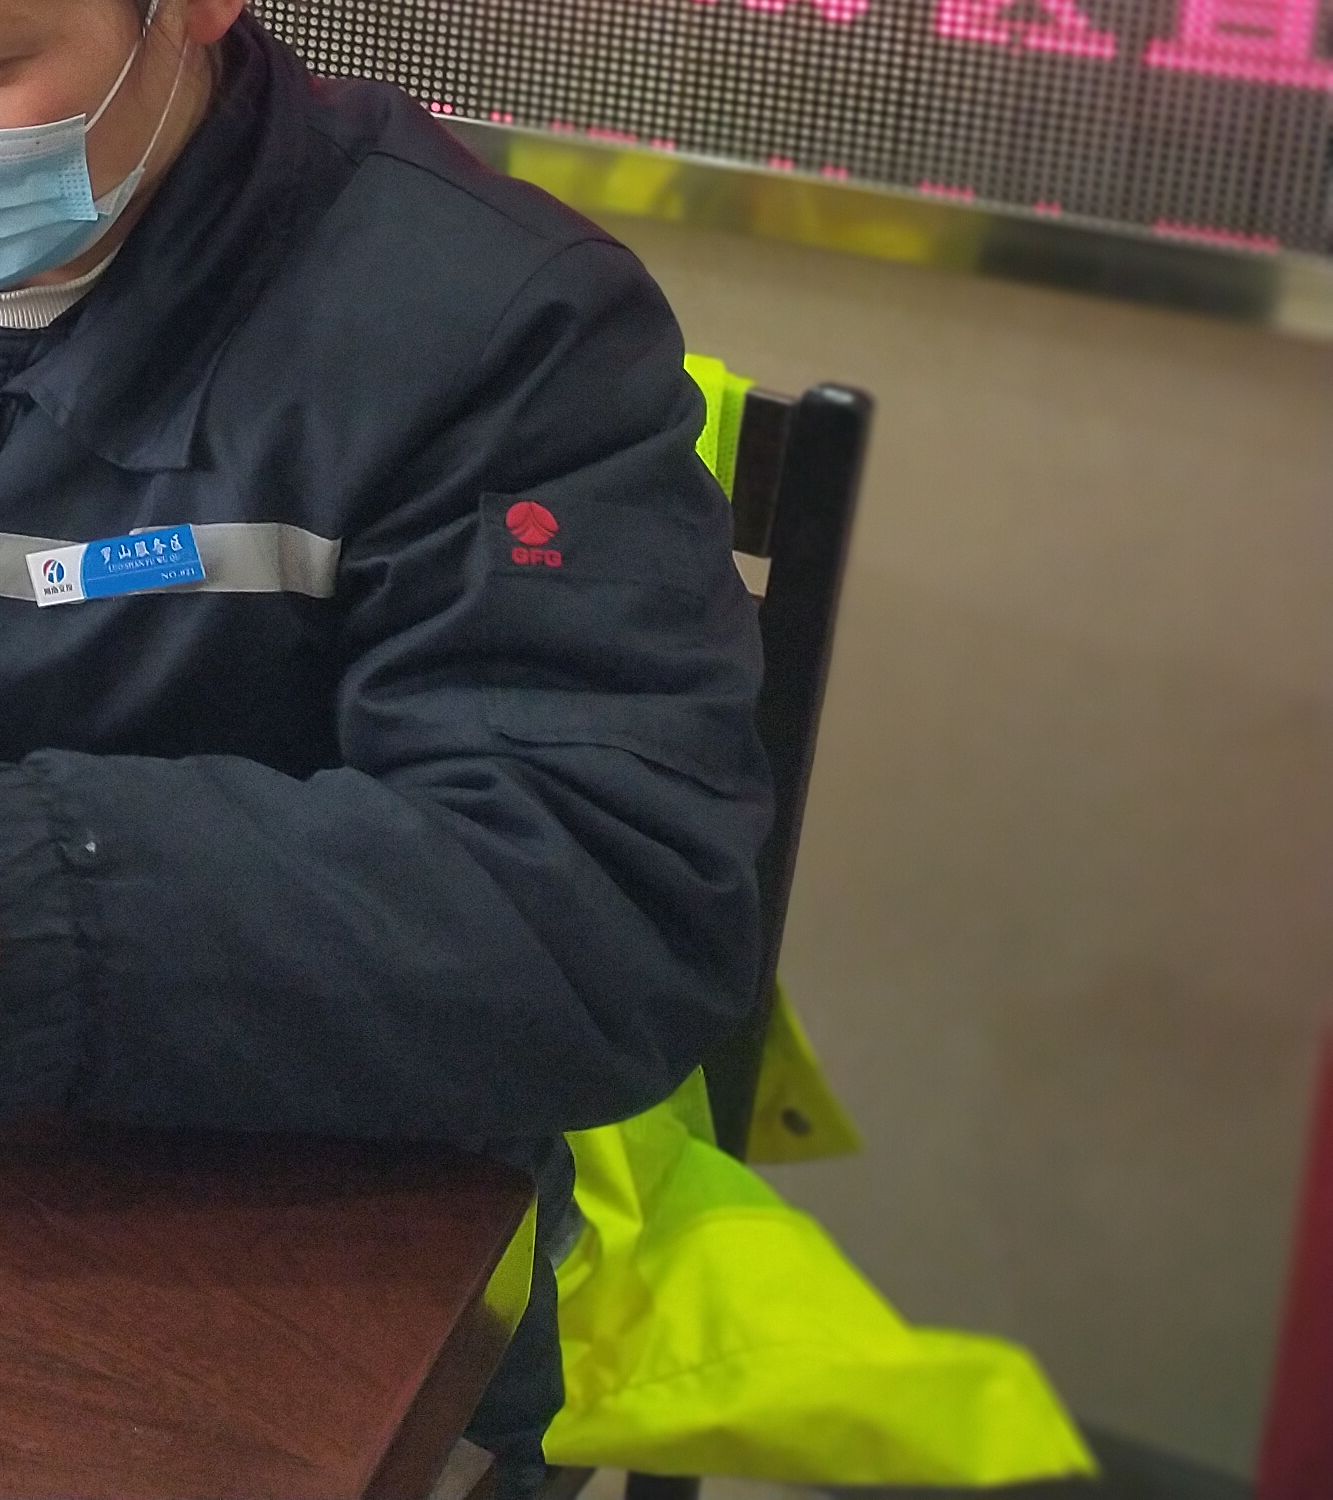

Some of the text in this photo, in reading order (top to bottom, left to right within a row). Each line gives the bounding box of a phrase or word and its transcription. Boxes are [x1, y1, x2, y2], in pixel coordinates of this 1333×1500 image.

[100, 533, 183, 565] 罗山服务区
